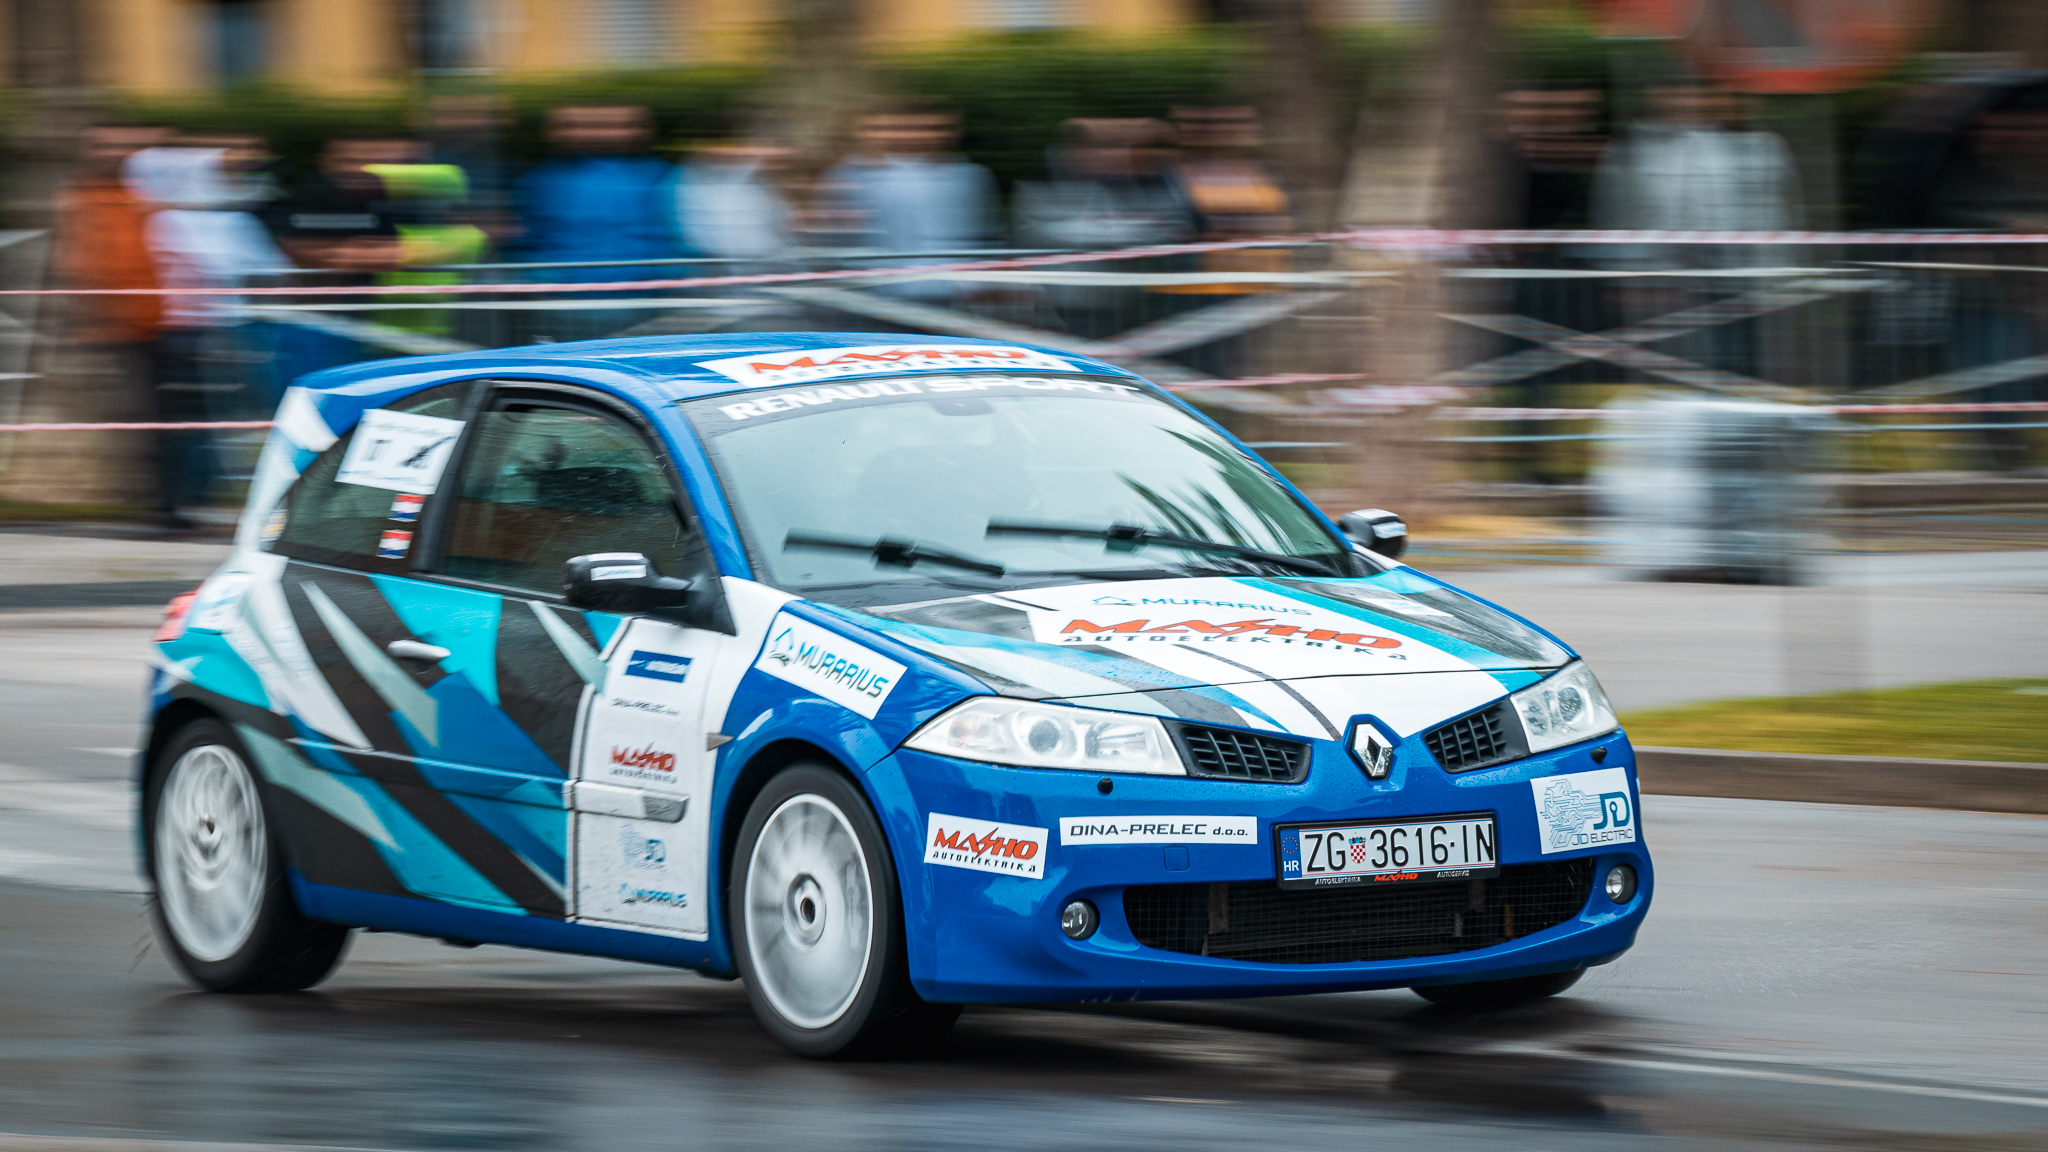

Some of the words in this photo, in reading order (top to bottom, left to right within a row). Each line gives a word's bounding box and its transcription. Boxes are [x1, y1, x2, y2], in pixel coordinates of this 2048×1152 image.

[720, 382, 924, 420] RENAULT
[923, 375, 1139, 396] SPORT
[1070, 823, 1208, 837] DINA-PRELEC
[1212, 826, 1249, 837] d.o.o.
[1590, 829, 1634, 844] ELECTRIC
[932, 850, 1037, 874] AUTOELEKTRIKA
[1304, 832, 1346, 873] ZG
[1283, 859, 1300, 872] HR
